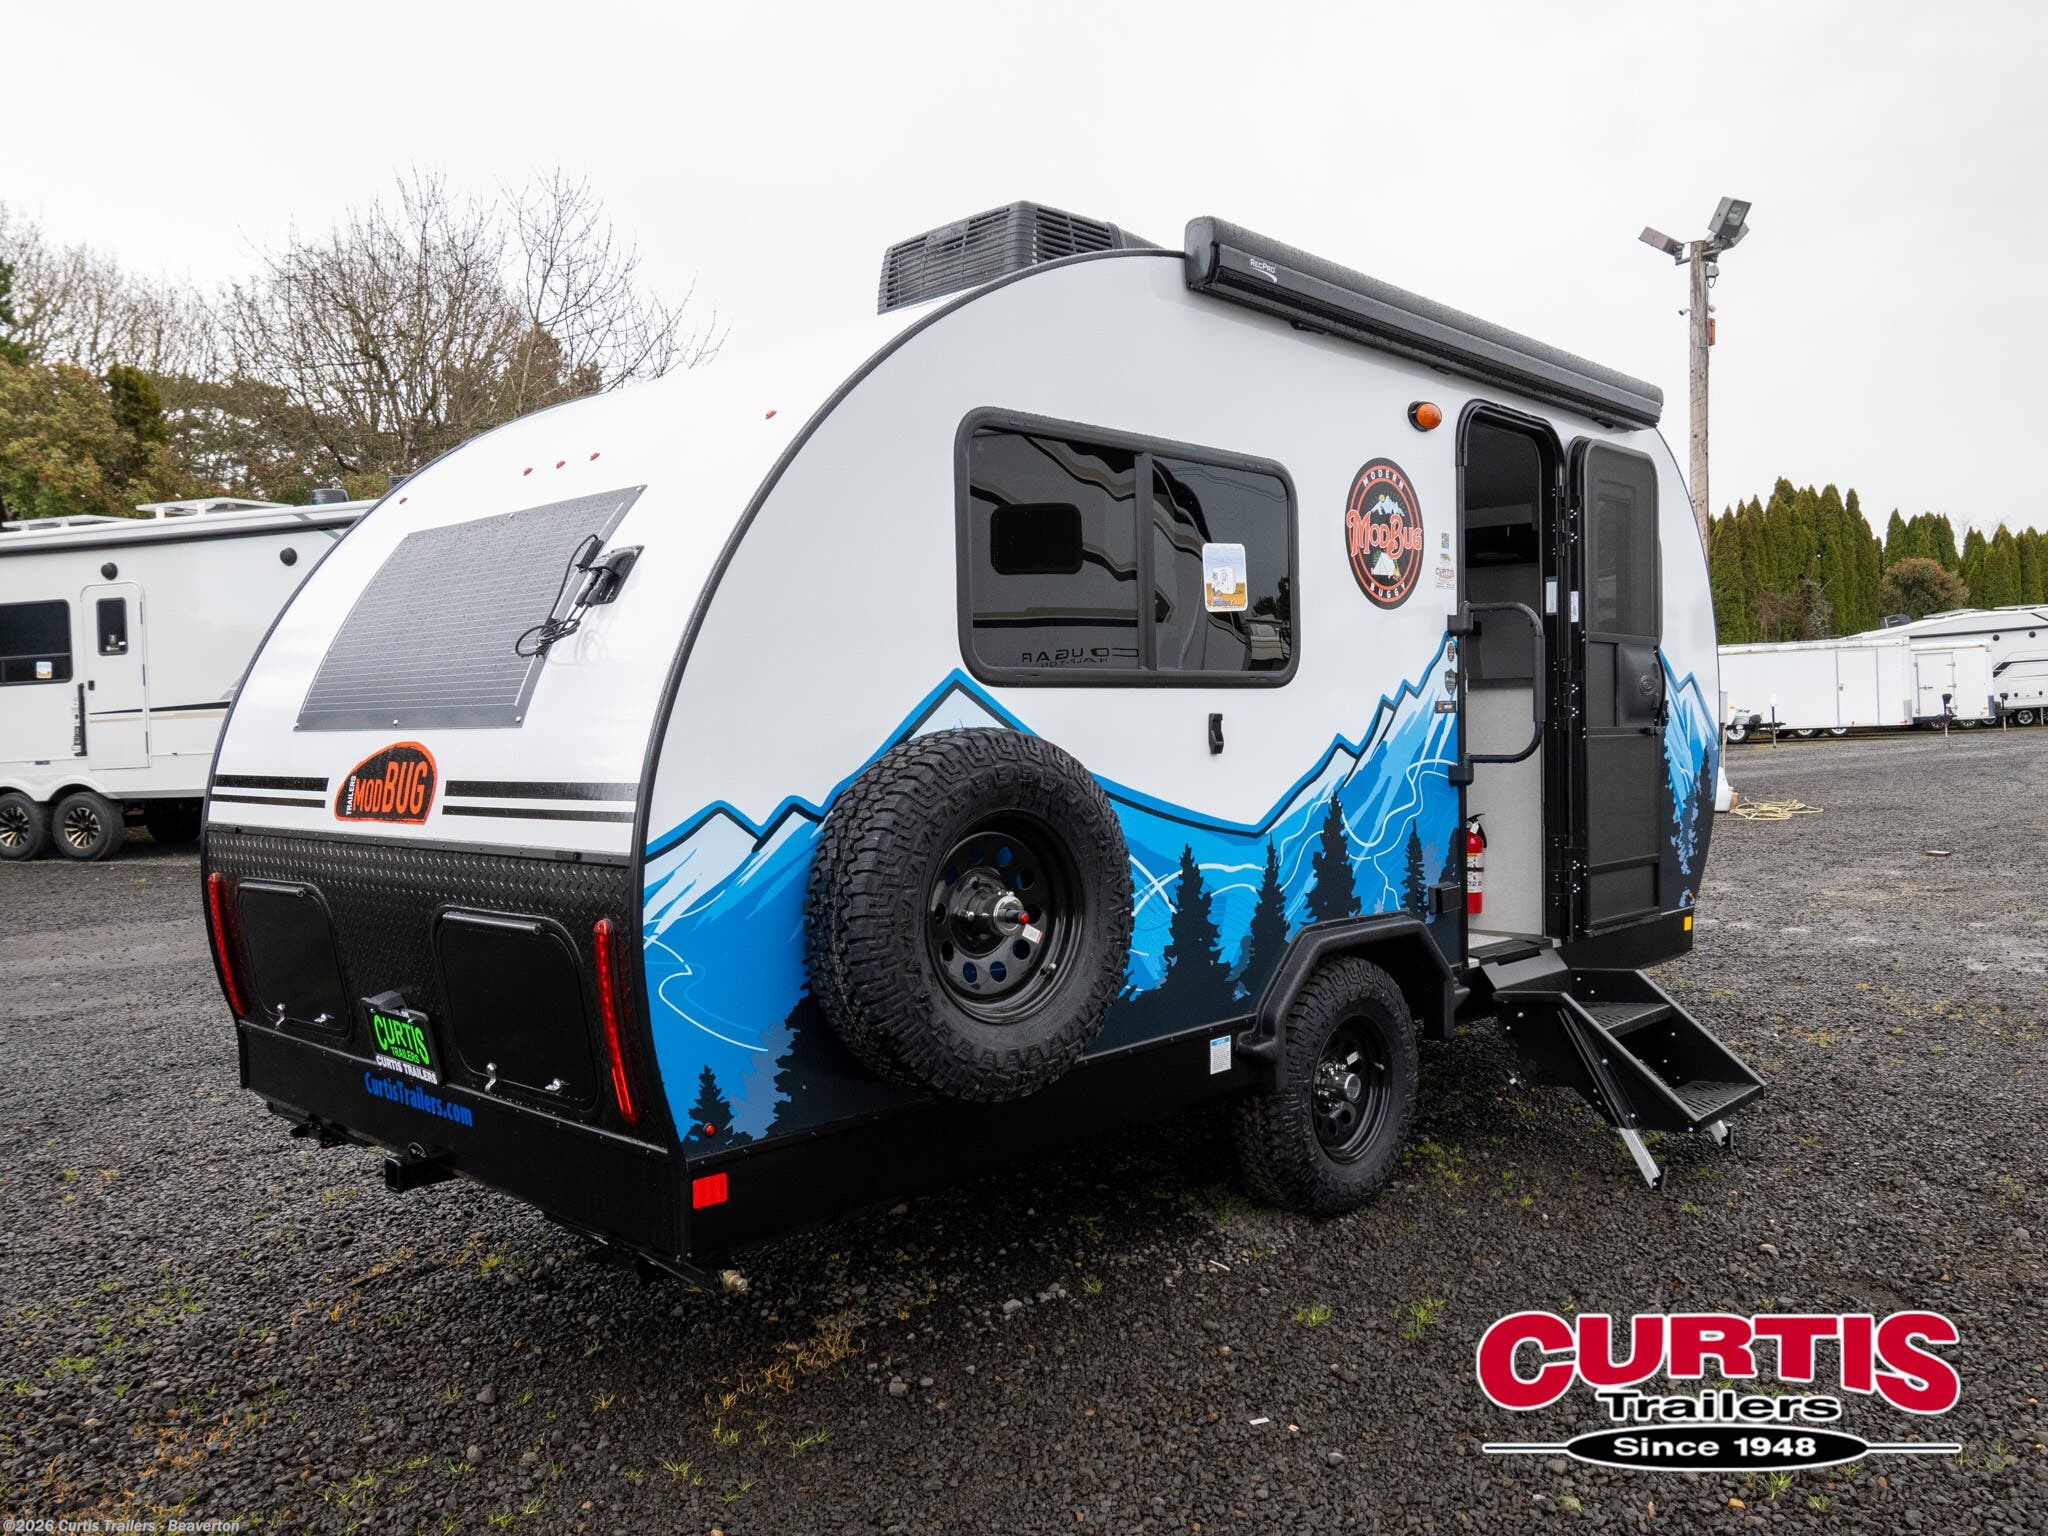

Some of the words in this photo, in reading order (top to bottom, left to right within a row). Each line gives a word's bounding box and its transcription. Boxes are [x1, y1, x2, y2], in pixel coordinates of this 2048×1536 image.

[1362, 469, 1404, 491] MODERN
[1370, 581, 1406, 599] BUGGY
[346, 775, 357, 816] TRAILERS
[373, 1014, 430, 1065] CURTIS
[376, 1055, 403, 1073] CURTIS
[403, 1063, 438, 1085] TRAILERS
[390, 1046, 420, 1064] TRAILERS
[364, 1071, 474, 1128] CurtisTrailers.com
